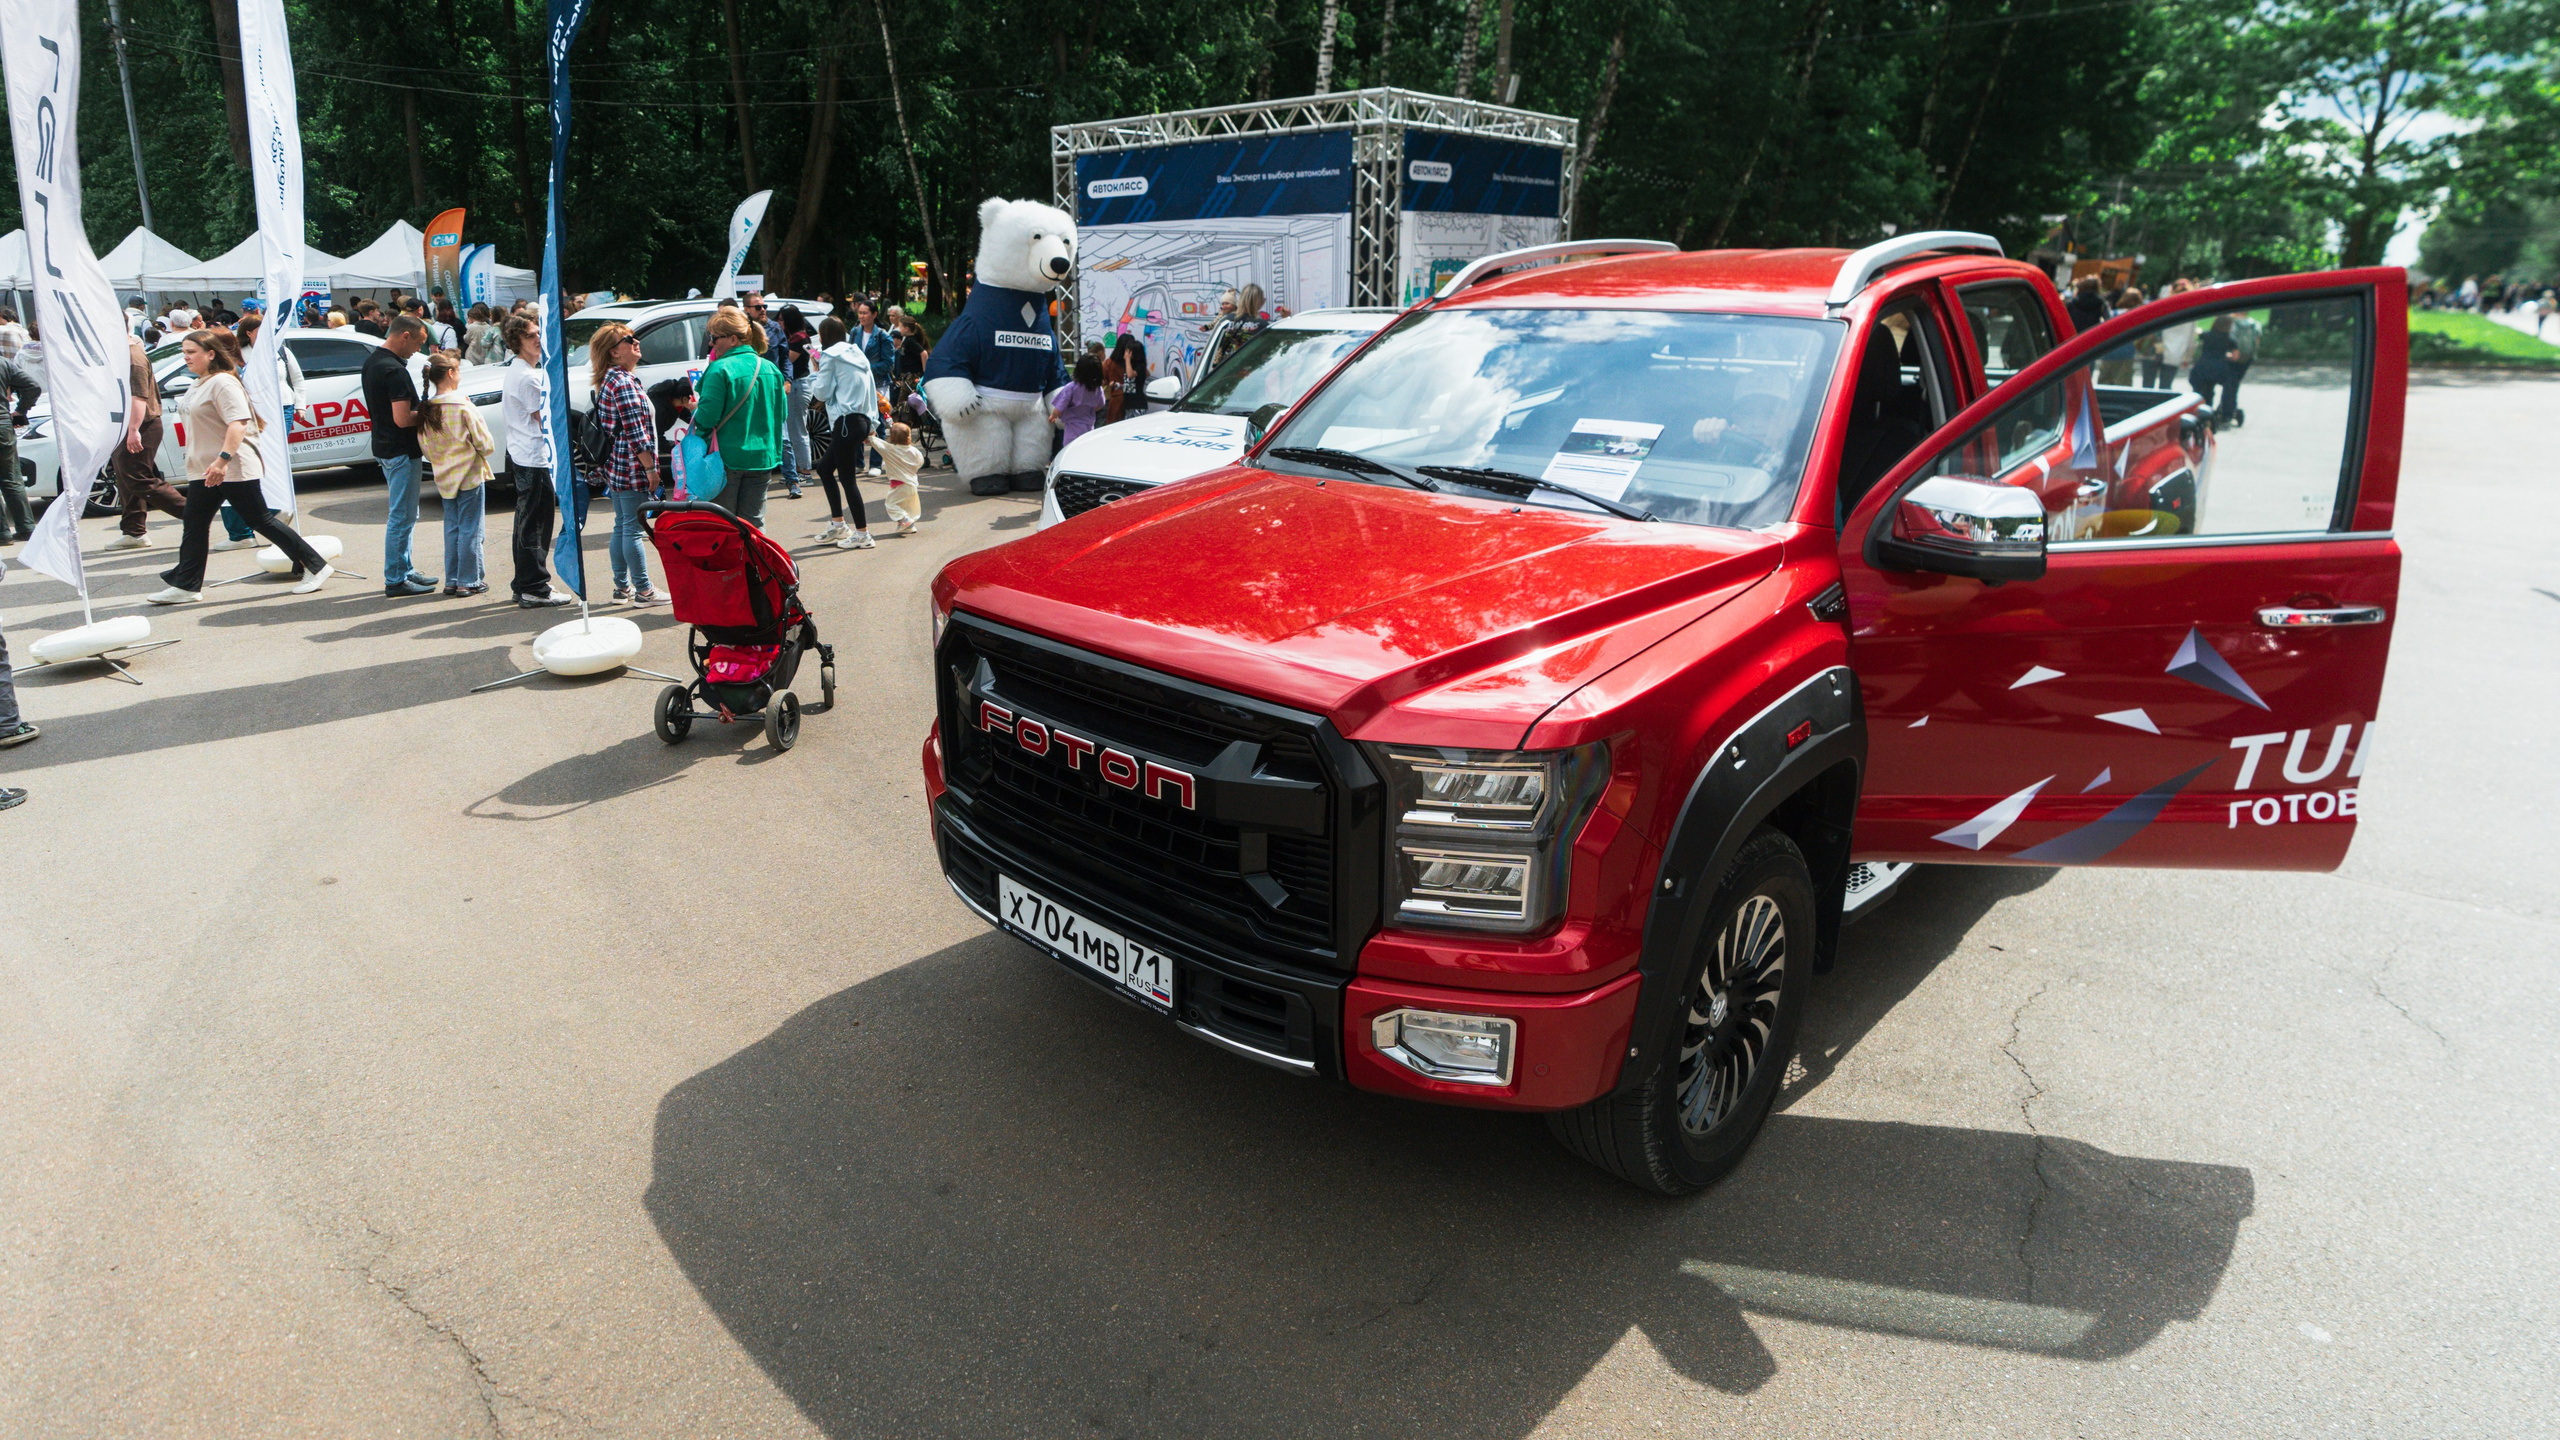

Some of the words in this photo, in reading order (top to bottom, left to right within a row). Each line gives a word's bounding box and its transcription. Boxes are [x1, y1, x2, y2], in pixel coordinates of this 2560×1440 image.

[1217, 175, 1232, 183] Ваш
[1233, 173, 1261, 183] Эксперт
[1268, 170, 1295, 180] выборе
[1296, 167, 1340, 178] автомобиля
[1092, 180, 1143, 194] АВТОКЛАСС
[998, 334, 1051, 347] АВТОКЛАСС
[301, 429, 328, 440] ТЕБЕ
[329, 423, 370, 436] РЕШАТЬ
[300, 442, 323, 453] (4872)
[324, 437, 356, 448] 38-12-12
[1124, 434, 1237, 451] SOLARIS
[980, 699, 1196, 811] FOTON
[1009, 891, 1120, 974] Х704МВ
[1129, 943, 1160, 985] 71
[1128, 973, 1152, 993] RUS
